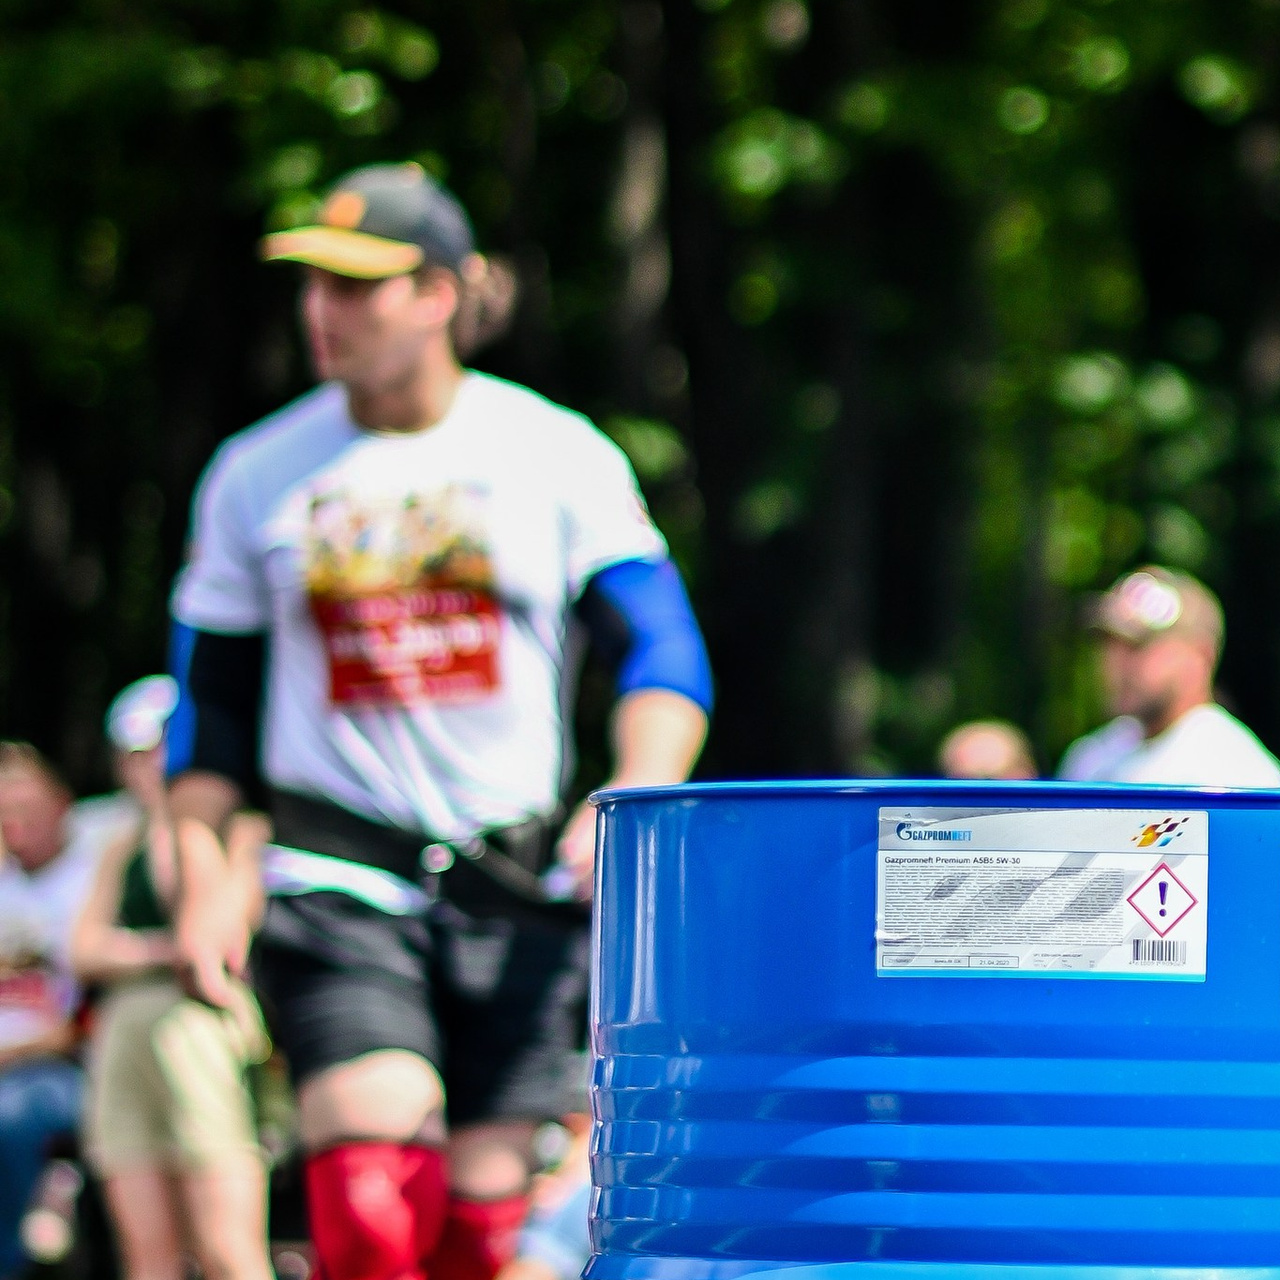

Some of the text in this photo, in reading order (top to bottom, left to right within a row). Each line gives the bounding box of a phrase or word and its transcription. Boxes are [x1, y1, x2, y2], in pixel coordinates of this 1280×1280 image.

[912, 830, 973, 842] GAZPROMNEFT
[884, 856, 1021, 865] Gazpromneft Premium A5B5 5W-30
